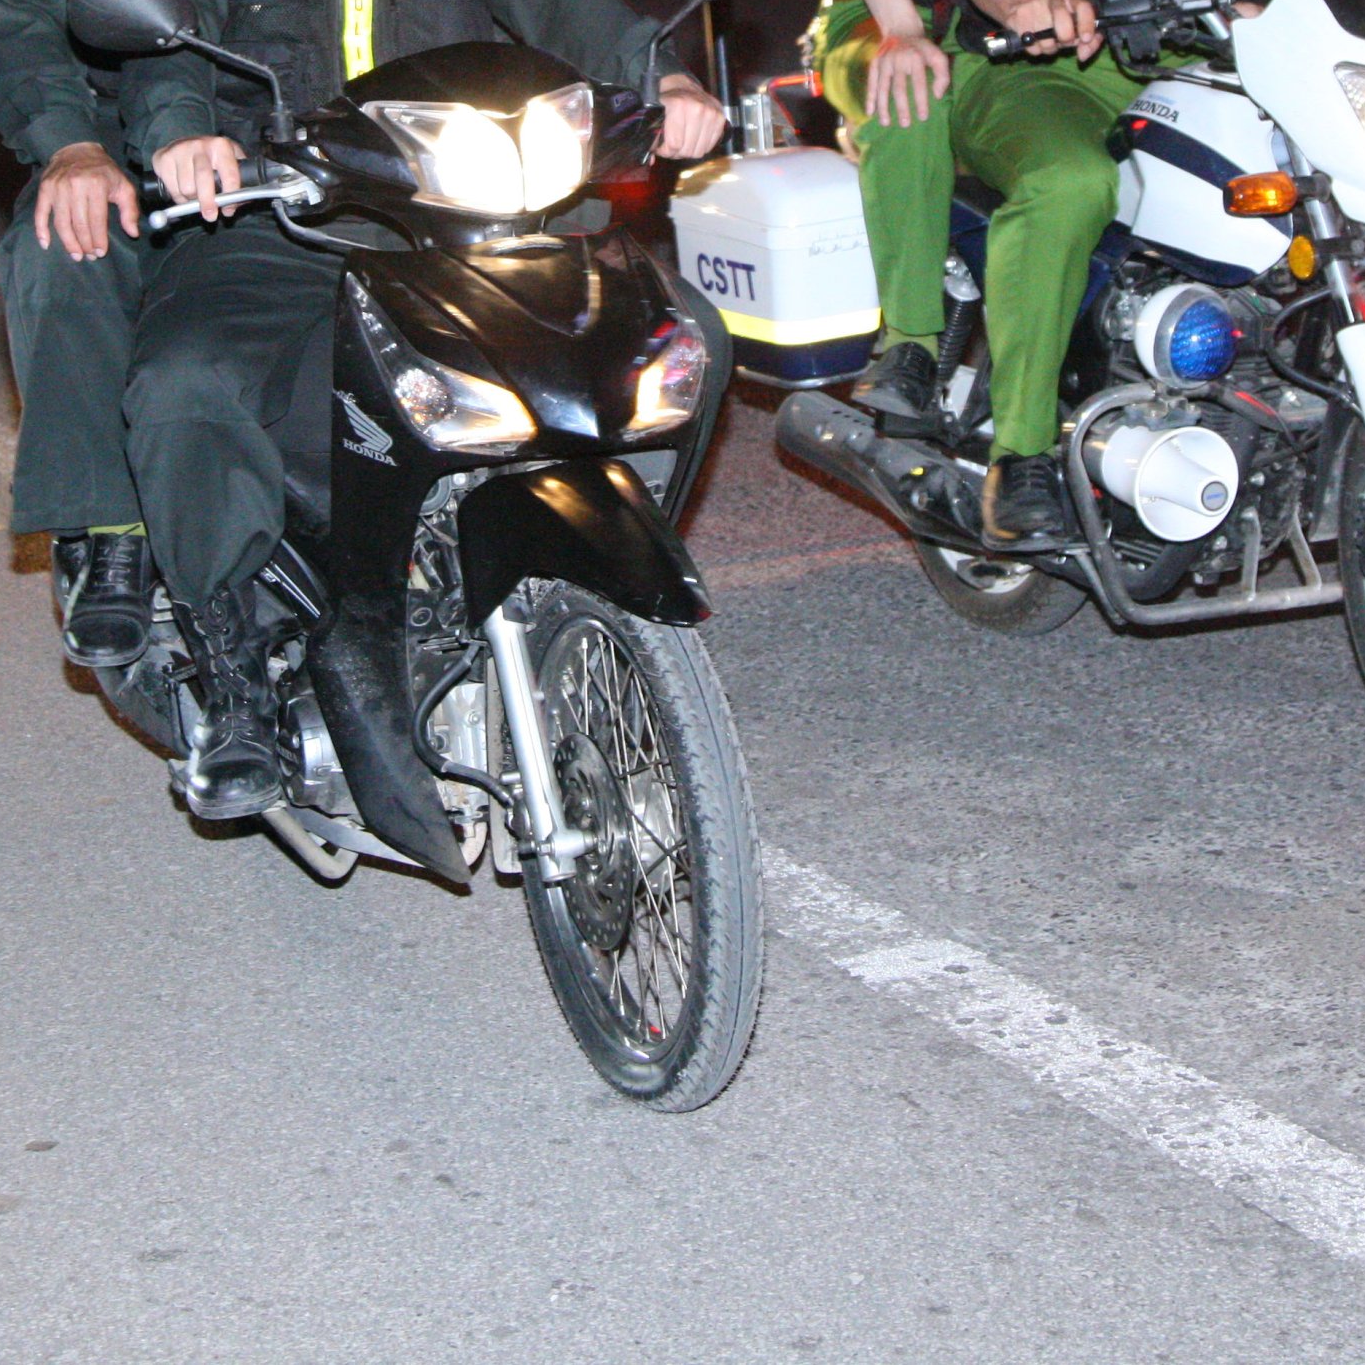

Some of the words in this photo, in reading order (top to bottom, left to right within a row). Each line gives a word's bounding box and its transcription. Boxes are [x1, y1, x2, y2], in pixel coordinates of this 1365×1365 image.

[1131, 99, 1179, 123] HONDA
[697, 252, 756, 302] CSTT
[342, 438, 397, 467] HONDA
